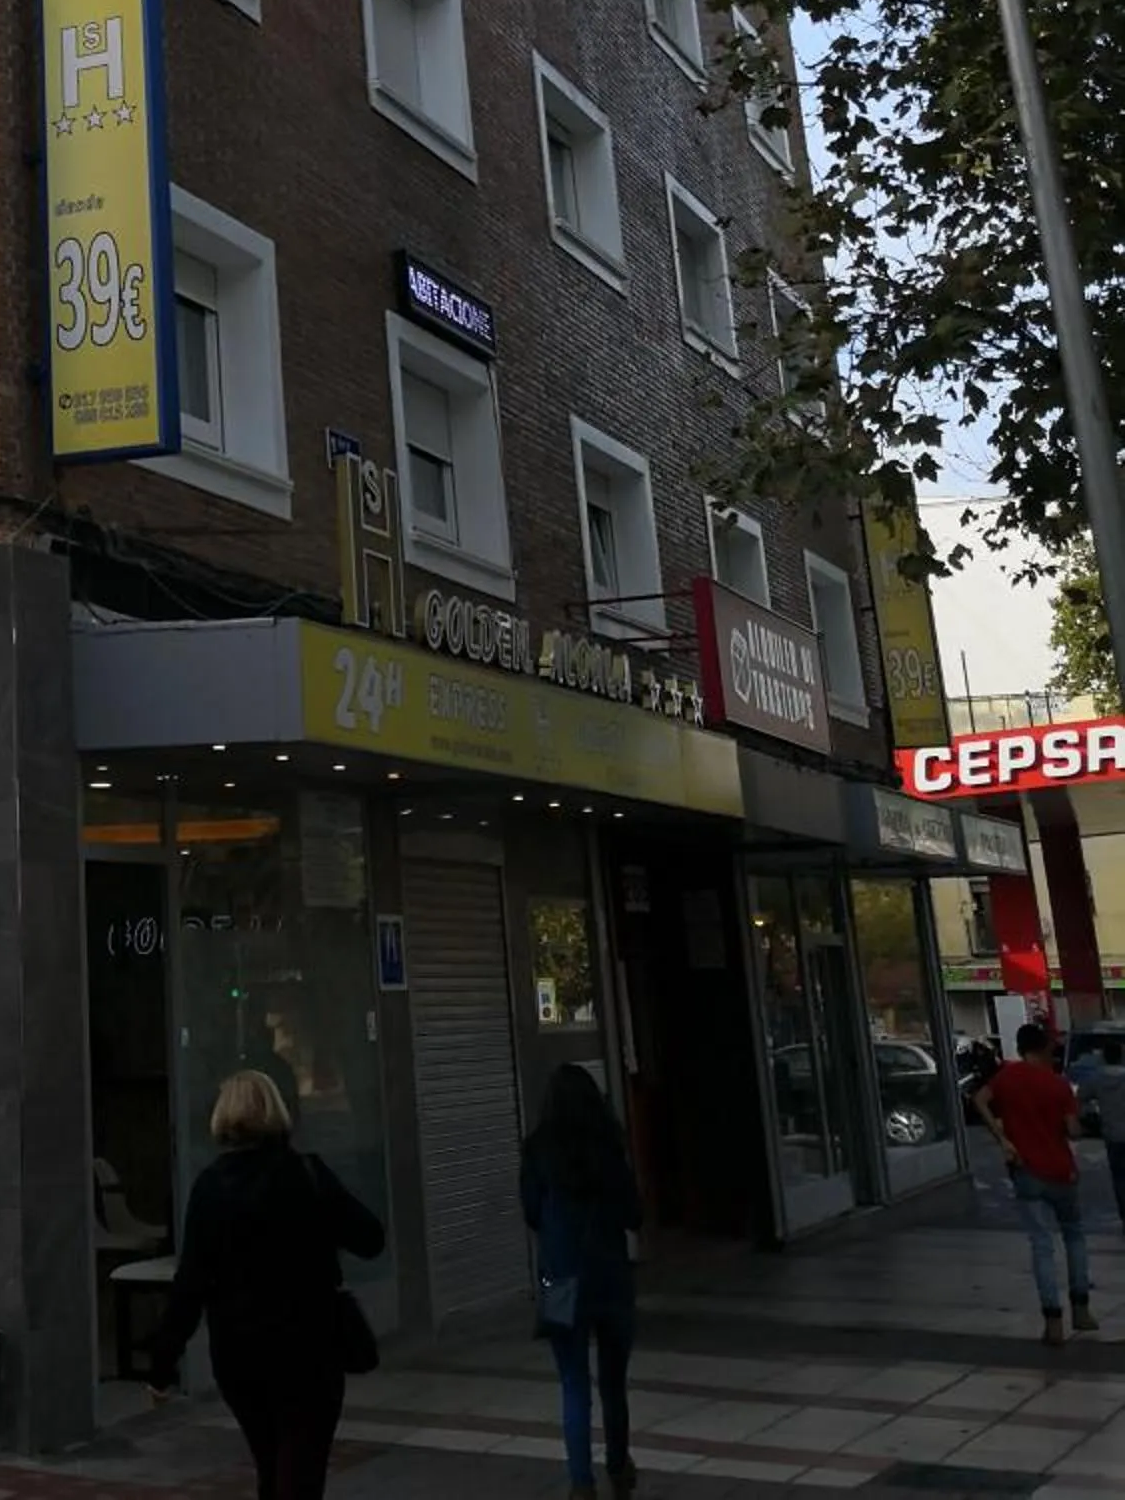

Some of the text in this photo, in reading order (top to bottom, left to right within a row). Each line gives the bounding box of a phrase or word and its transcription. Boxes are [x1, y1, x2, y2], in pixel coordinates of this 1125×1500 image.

[55, 231, 148, 352] 39€
[422, 589, 533, 674] GOLDEN
[427, 673, 509, 731] EXPRESS
[913, 725, 1125, 793] CEPSA
